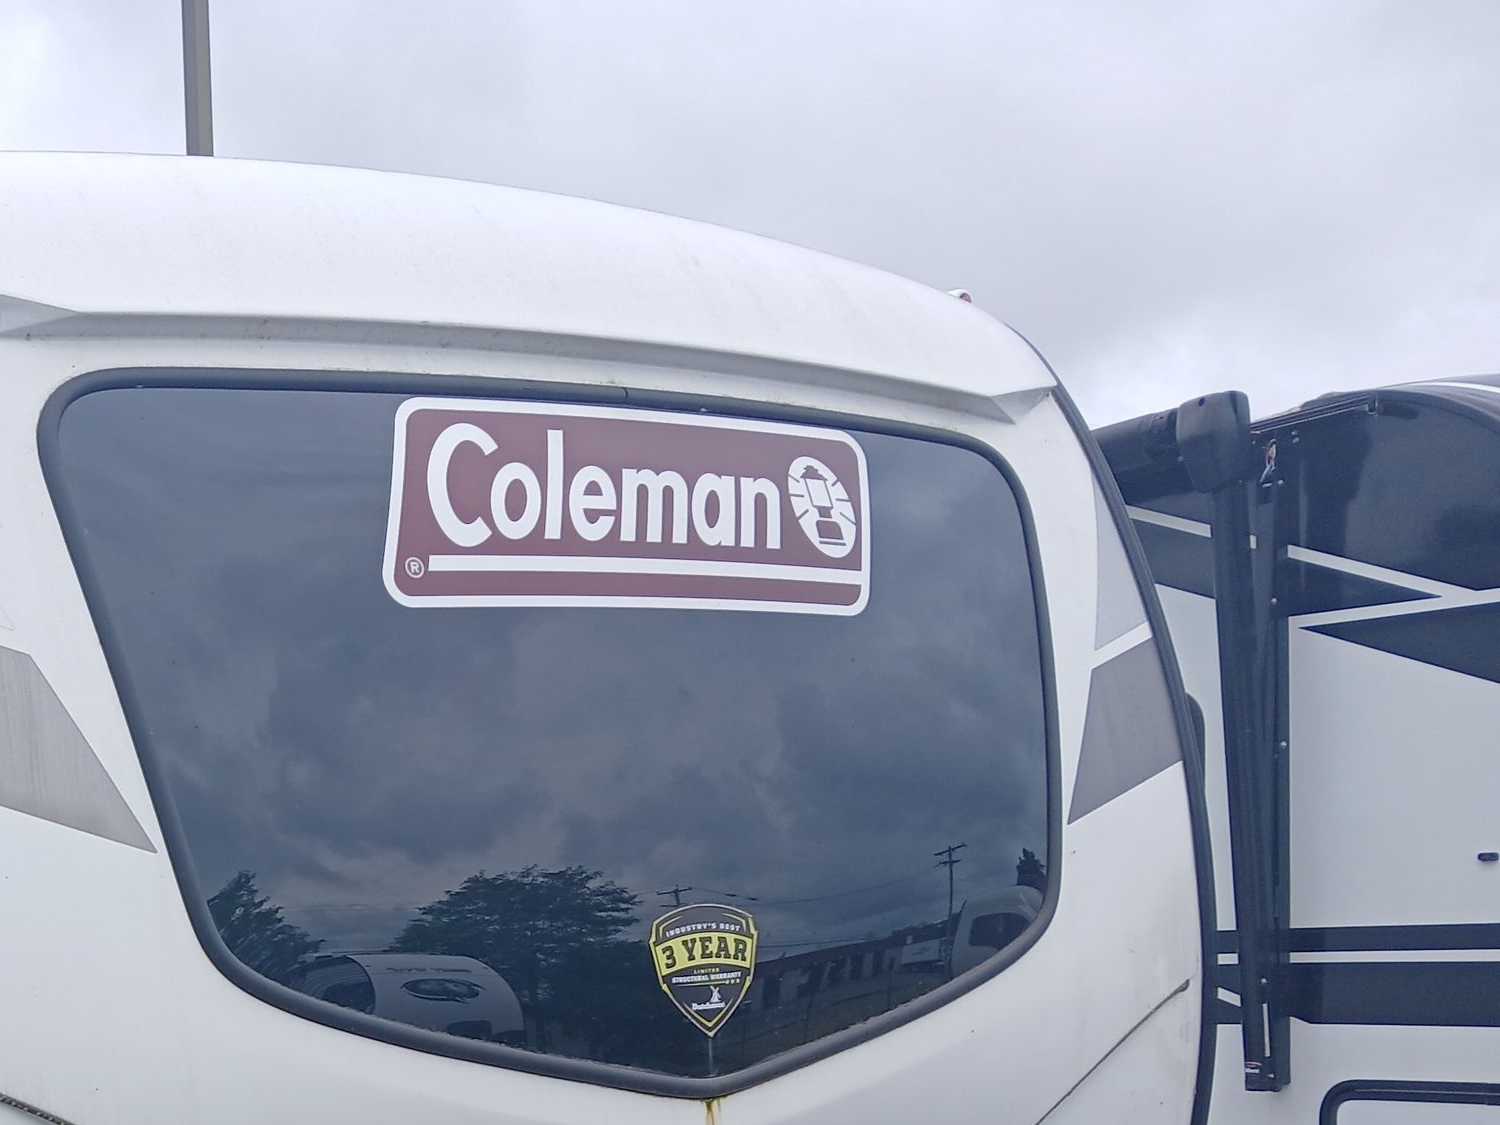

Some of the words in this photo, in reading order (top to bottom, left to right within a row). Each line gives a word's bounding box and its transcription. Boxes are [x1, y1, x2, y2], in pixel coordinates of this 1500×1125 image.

[426, 422, 781, 549] Coleman
[665, 922, 717, 938] INDUSTRY'S
[719, 922, 741, 932] BEST
[661, 945, 677, 969] 3
[681, 935, 748, 962] YEAR
